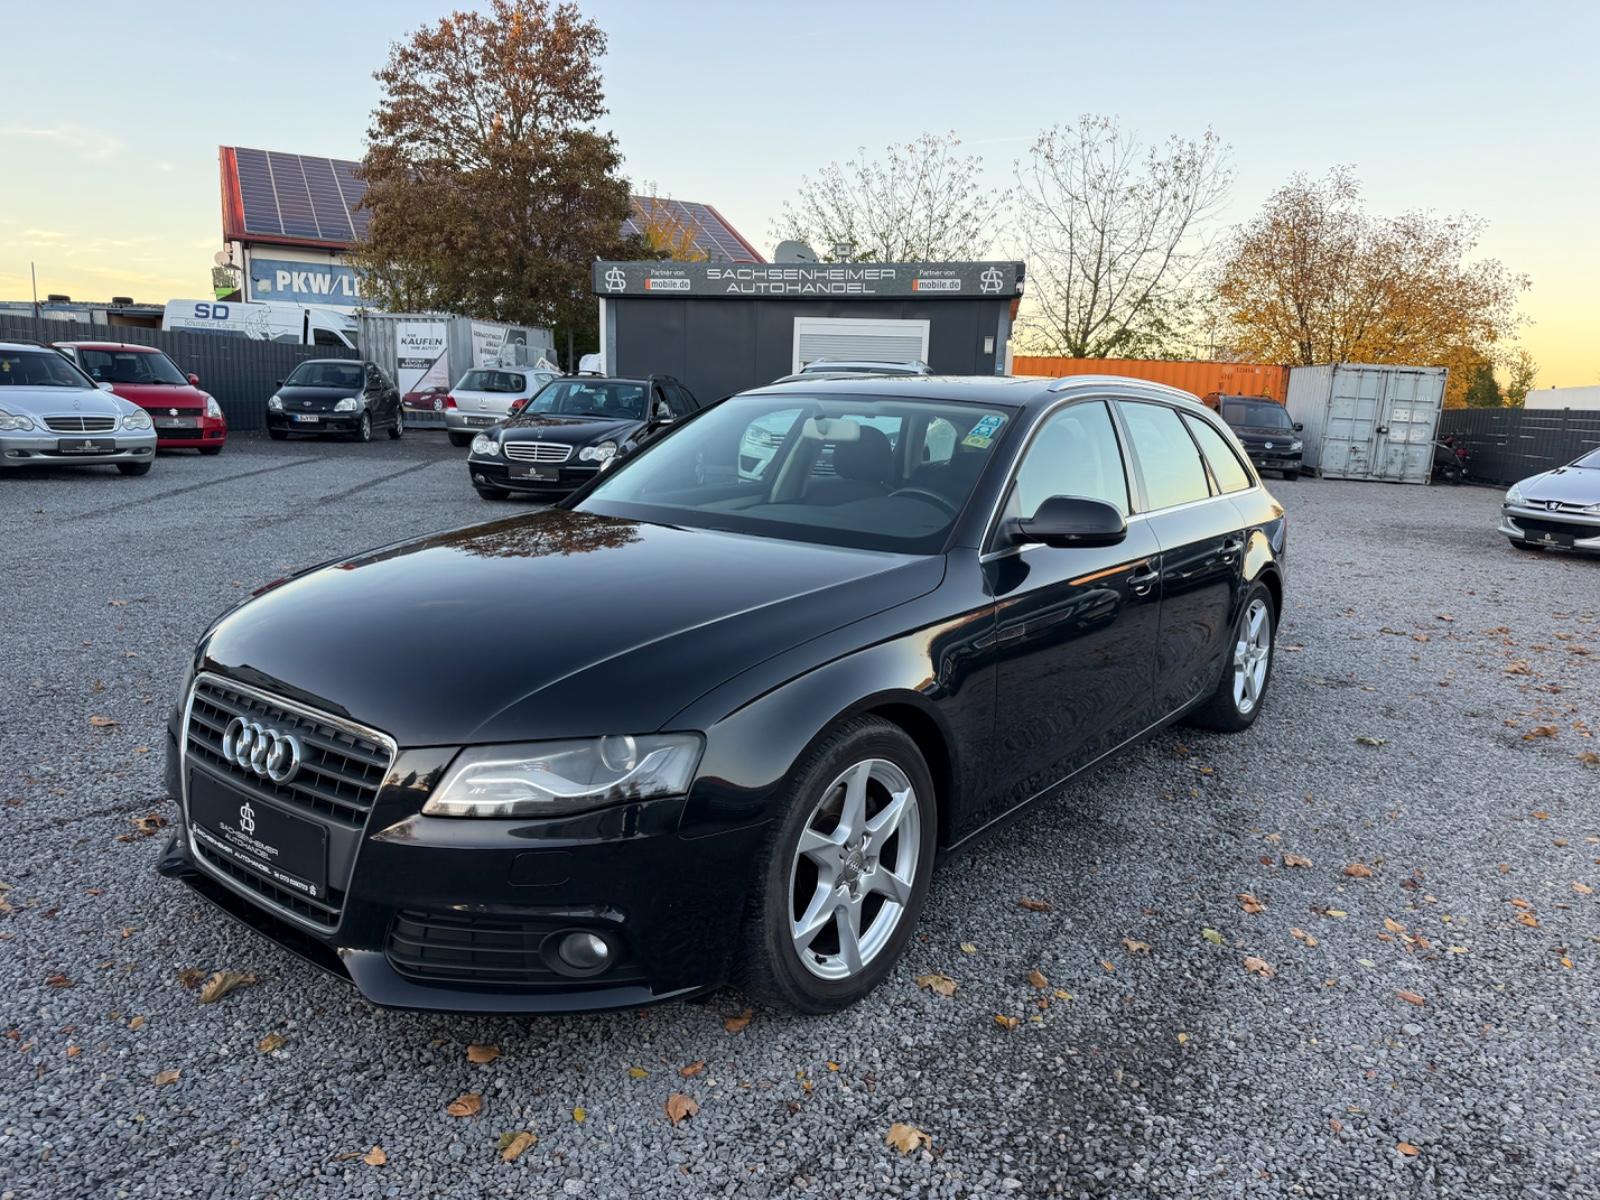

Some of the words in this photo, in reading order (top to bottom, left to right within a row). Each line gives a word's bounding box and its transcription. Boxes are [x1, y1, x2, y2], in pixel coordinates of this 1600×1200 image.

[707, 269, 896, 280] SACHSENHEIMER
[651, 280, 689, 289] mobile.de
[726, 282, 876, 294] AUTOHANDEL
[920, 280, 960, 289] mobile.de
[194, 303, 229, 320] SD
[401, 337, 443, 346] KAUFEN
